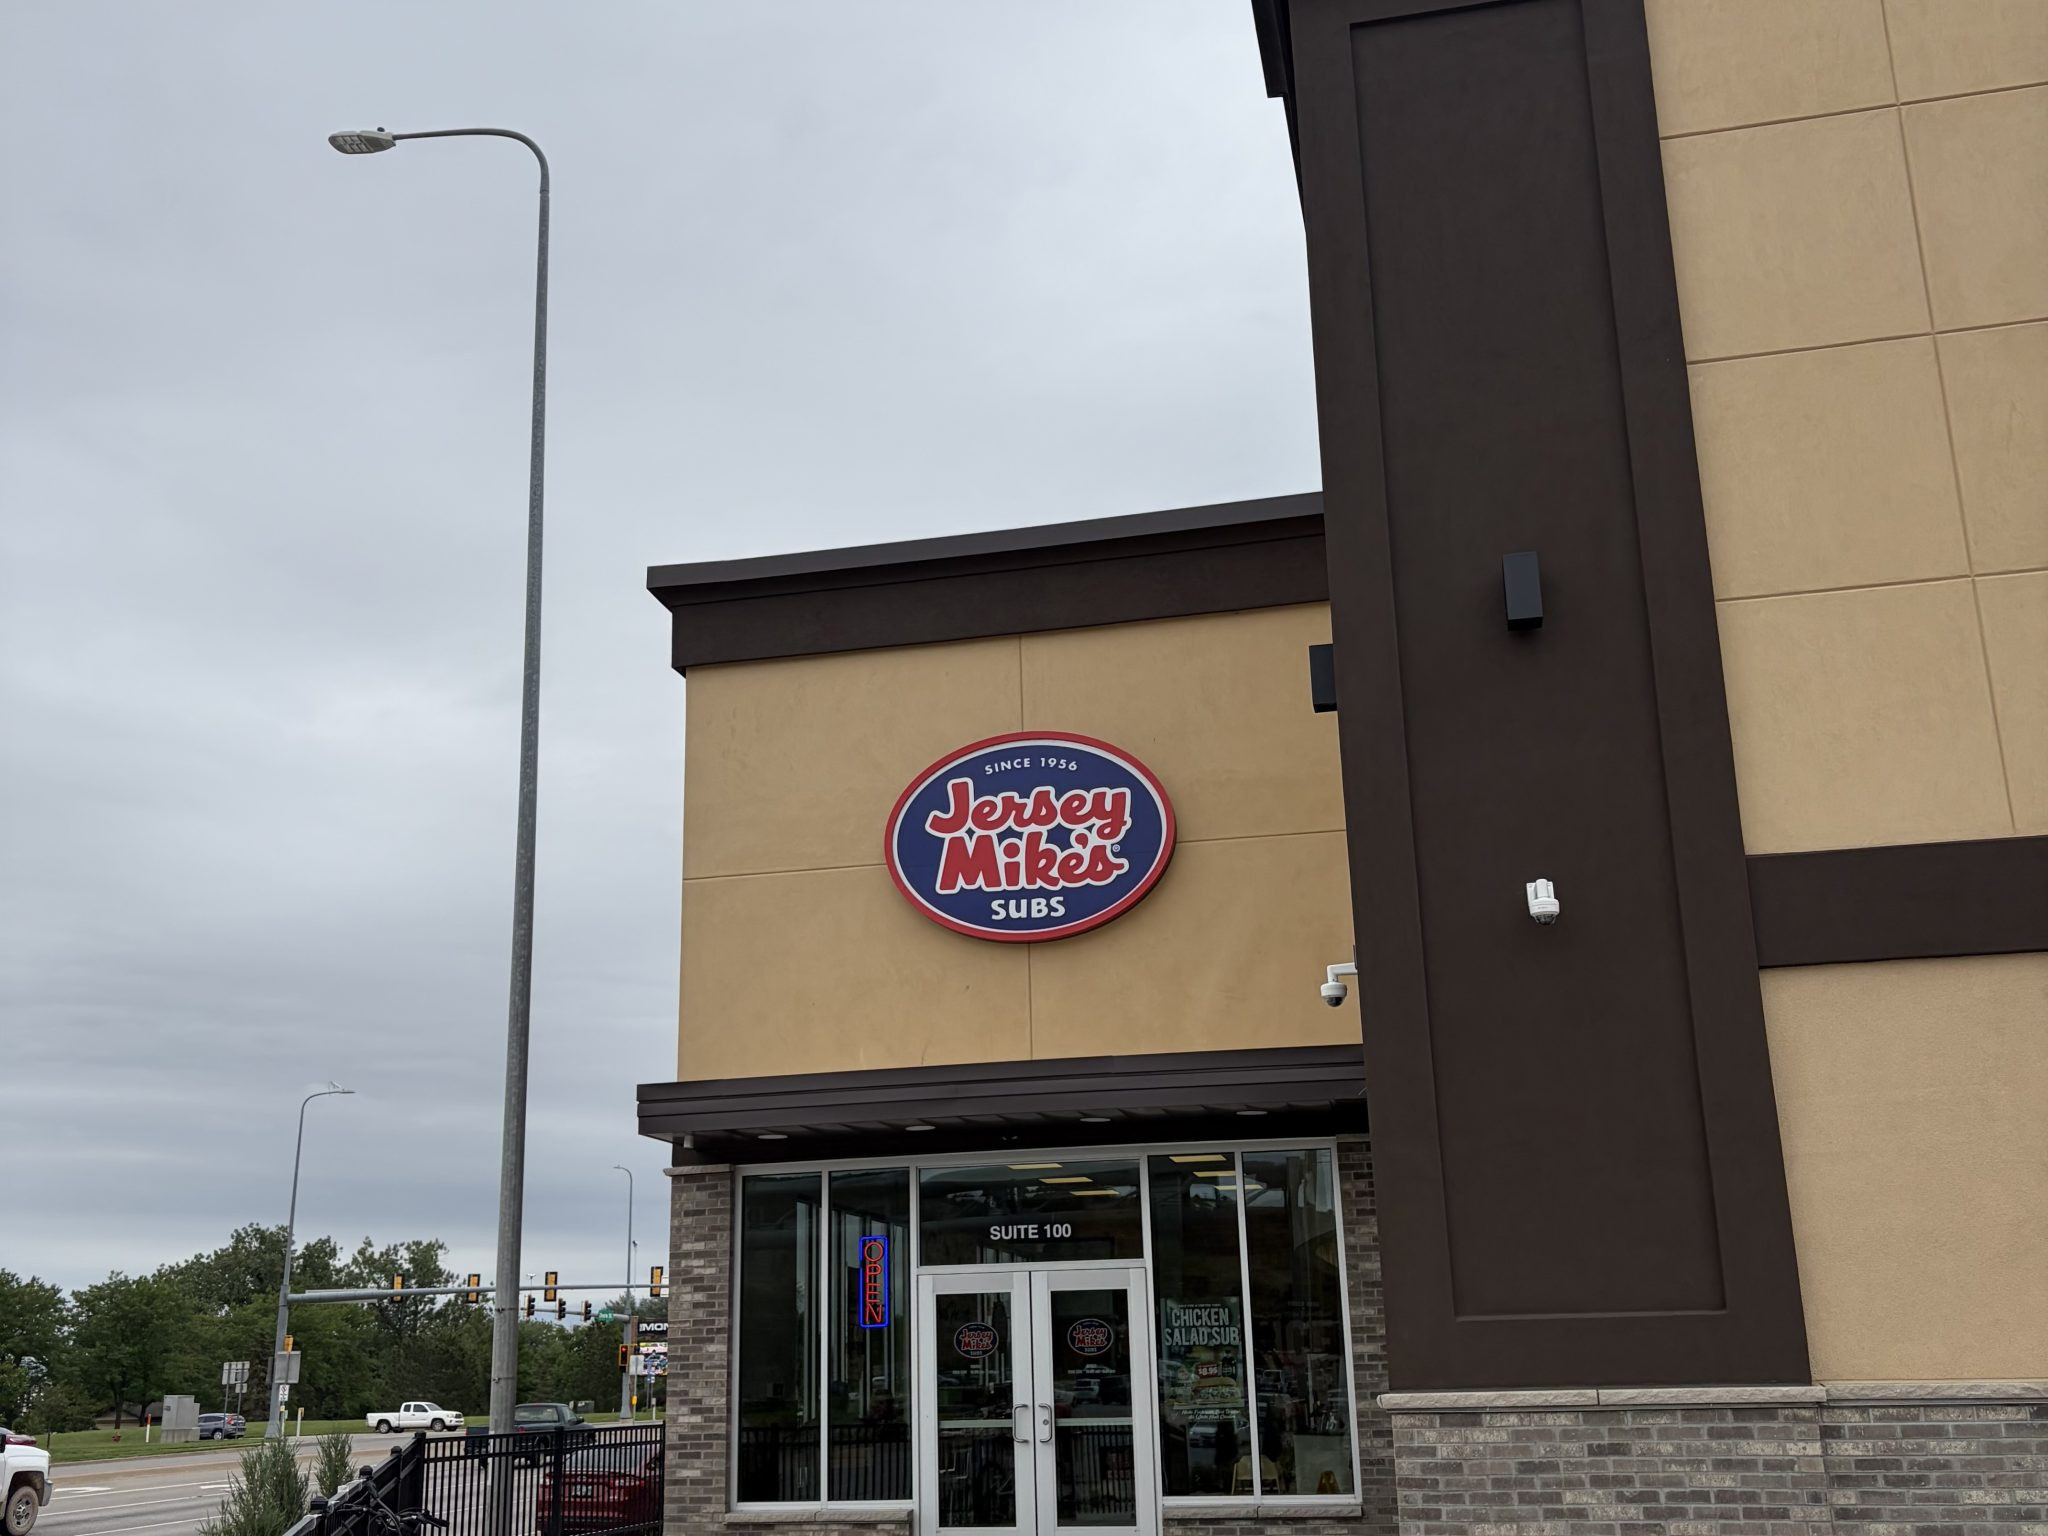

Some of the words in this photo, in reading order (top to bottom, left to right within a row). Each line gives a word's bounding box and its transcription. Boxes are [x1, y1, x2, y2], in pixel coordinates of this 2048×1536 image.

[984, 757, 1031, 775] SINCE
[1040, 757, 1078, 771] 1956
[926, 777, 1131, 844] Jersey
[937, 830, 1129, 894] Mike's
[991, 896, 1066, 920] SUBS
[990, 1225, 1039, 1240] SUITE
[1043, 1223, 1072, 1238] 100
[864, 1241, 884, 1323] OPEN
[1172, 1308, 1230, 1327] CHICKEN
[959, 1329, 993, 1342] Jersey
[1072, 1325, 1107, 1338] Jersey
[1165, 1327, 1208, 1346] SALAD
[1211, 1327, 1239, 1346] SUB
